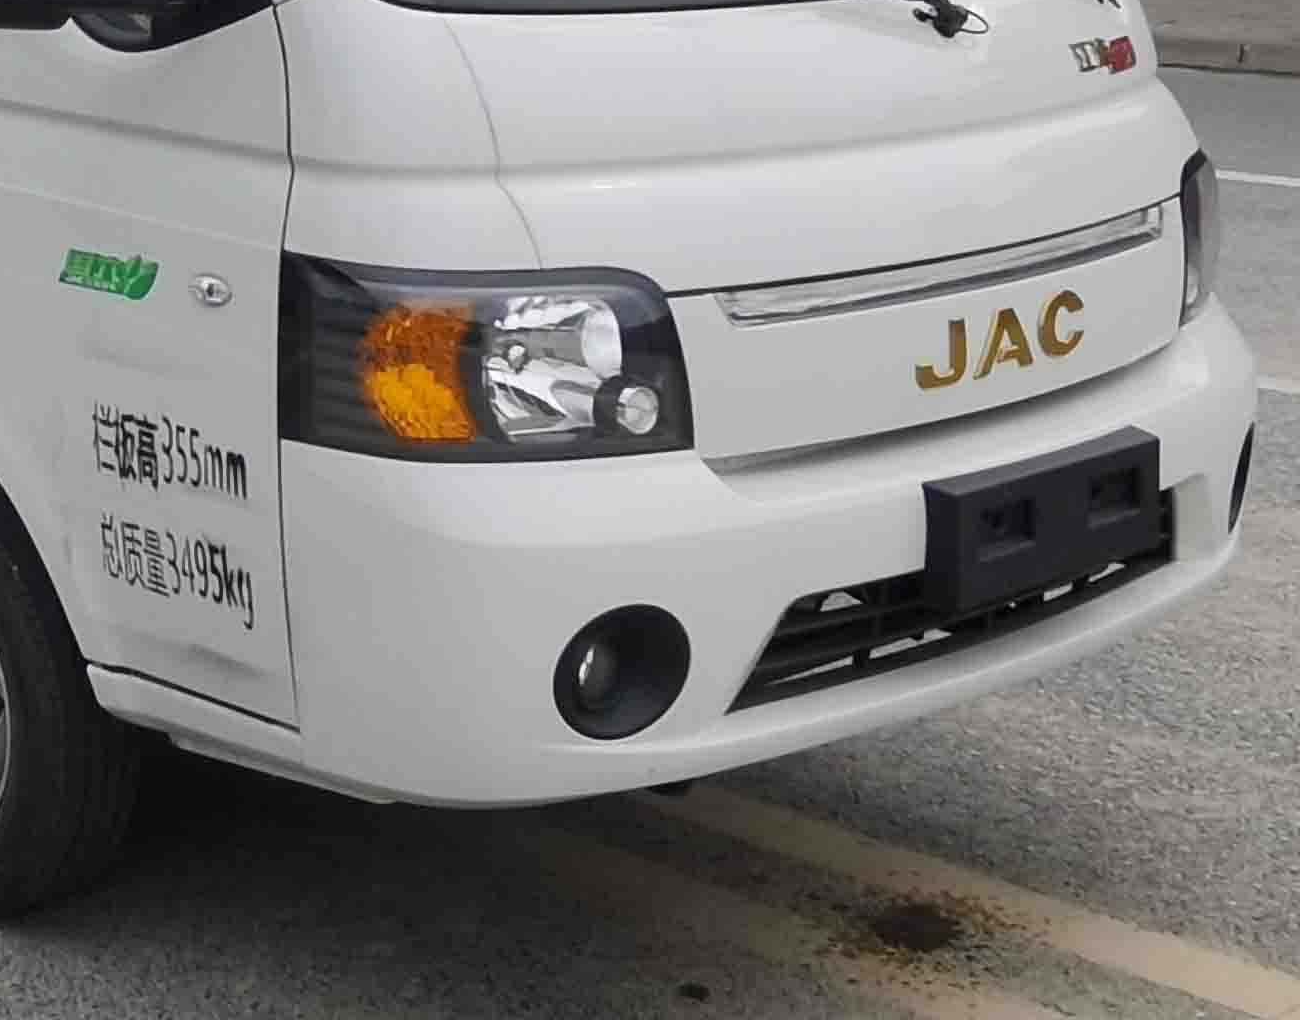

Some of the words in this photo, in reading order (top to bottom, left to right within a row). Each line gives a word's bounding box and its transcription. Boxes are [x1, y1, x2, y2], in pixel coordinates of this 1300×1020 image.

[915, 289, 1085, 390] JAC
[101, 513, 254, 630] 总质量3495kg
